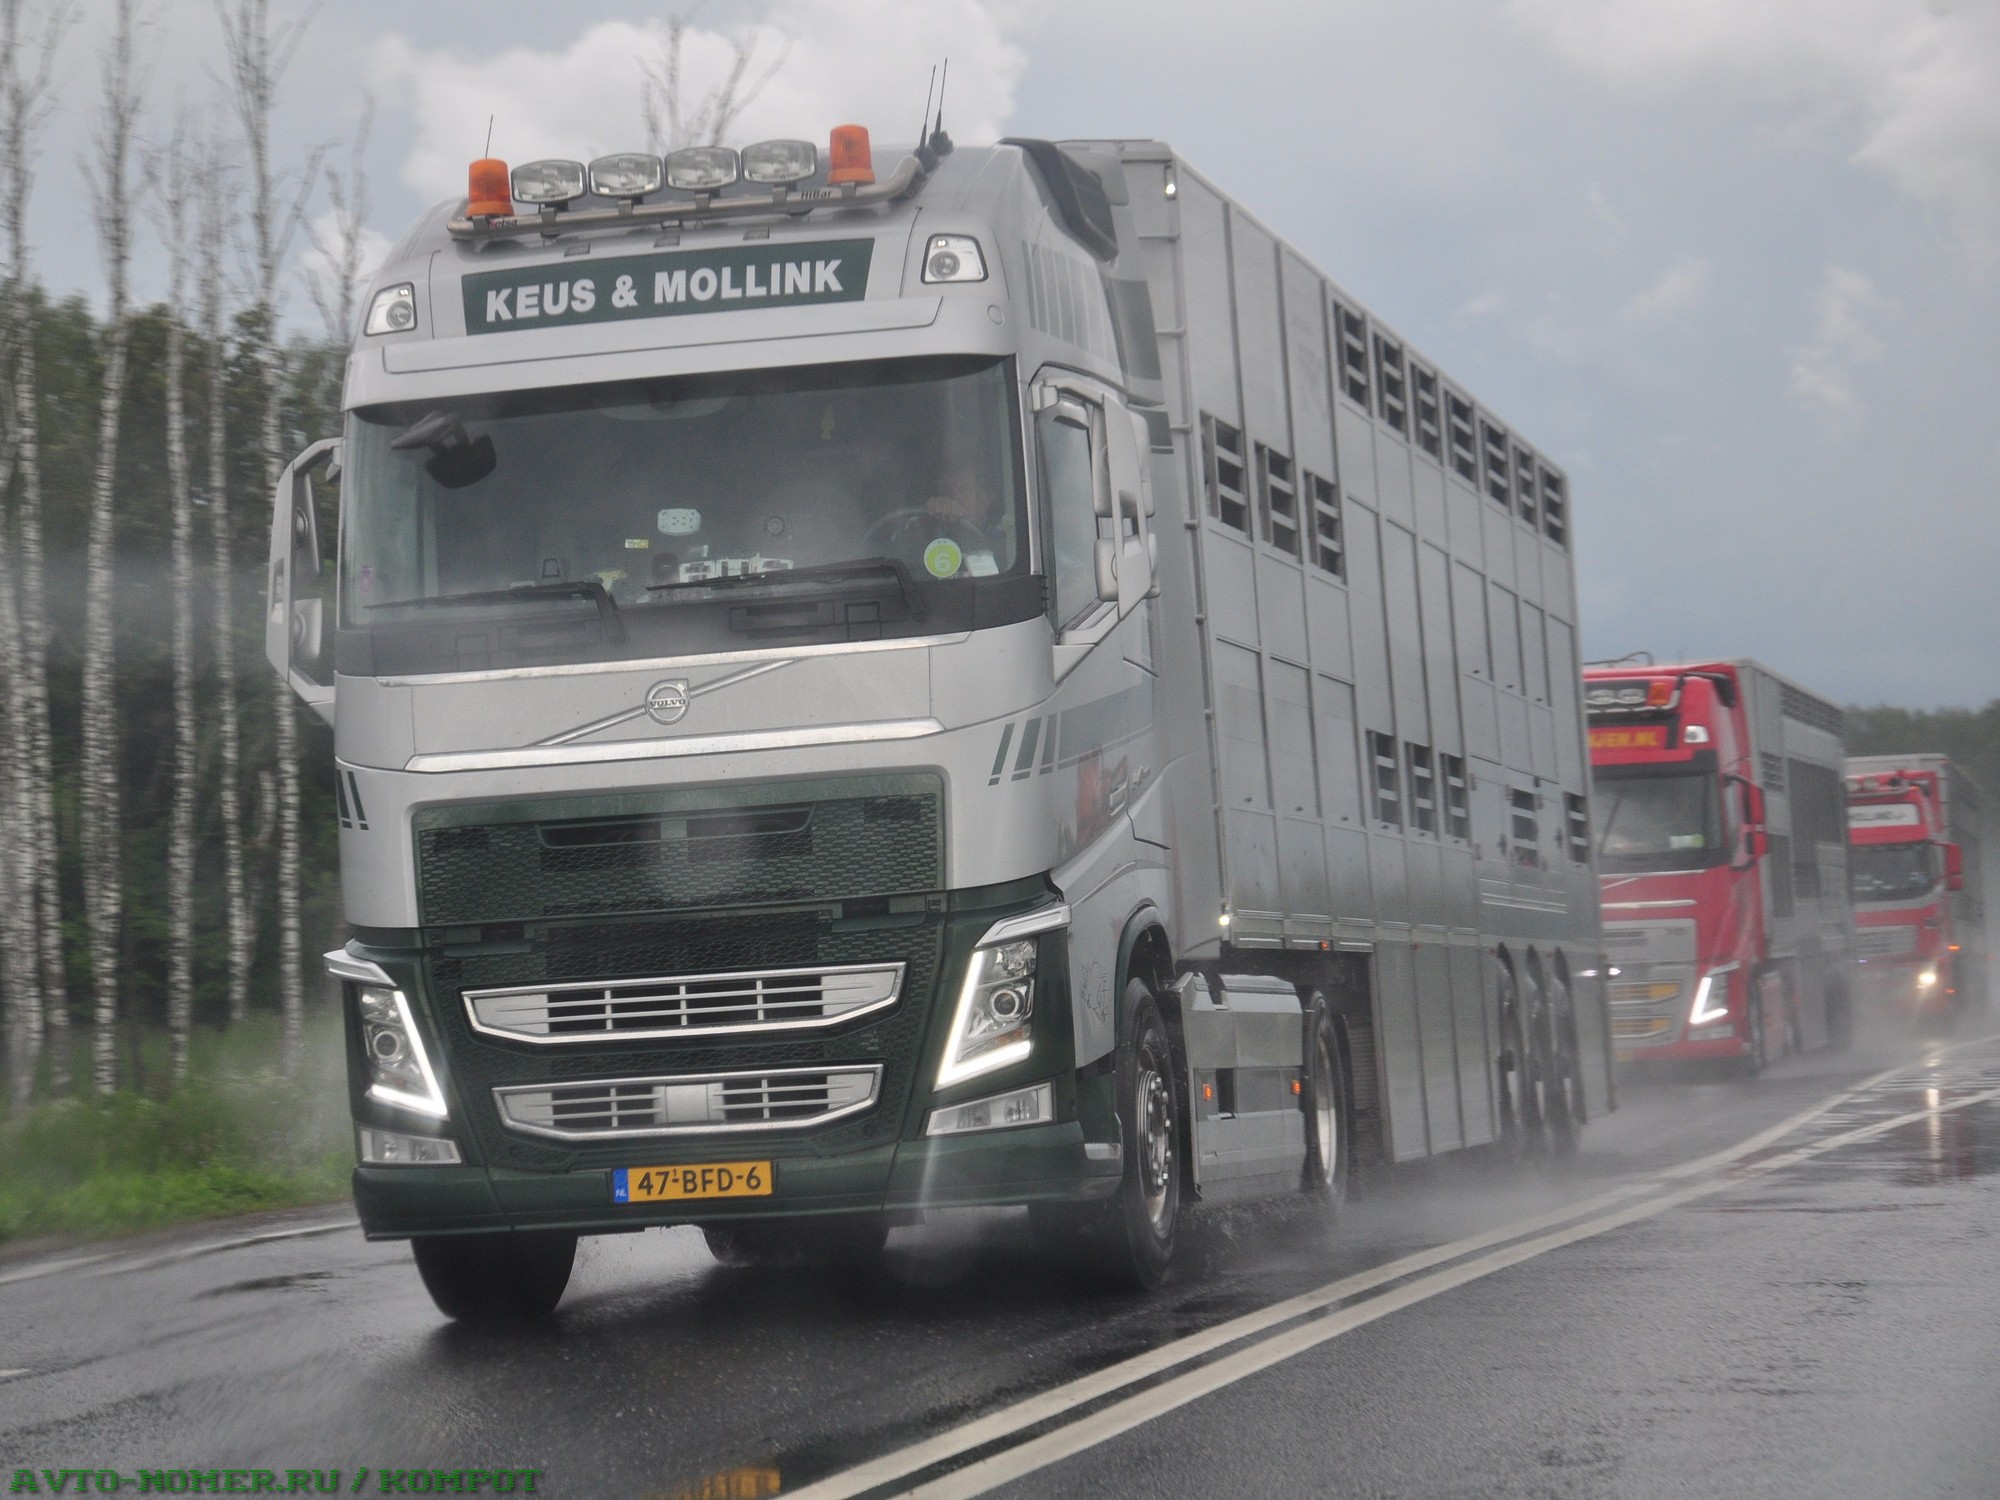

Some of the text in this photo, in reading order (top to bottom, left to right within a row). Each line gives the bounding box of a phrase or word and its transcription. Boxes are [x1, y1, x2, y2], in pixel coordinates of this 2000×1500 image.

[486, 258, 844, 322] KEUS & MOLLINK
[934, 551, 952, 573] 6
[650, 698, 686, 707] VOLVO
[615, 1189, 627, 1197] NL
